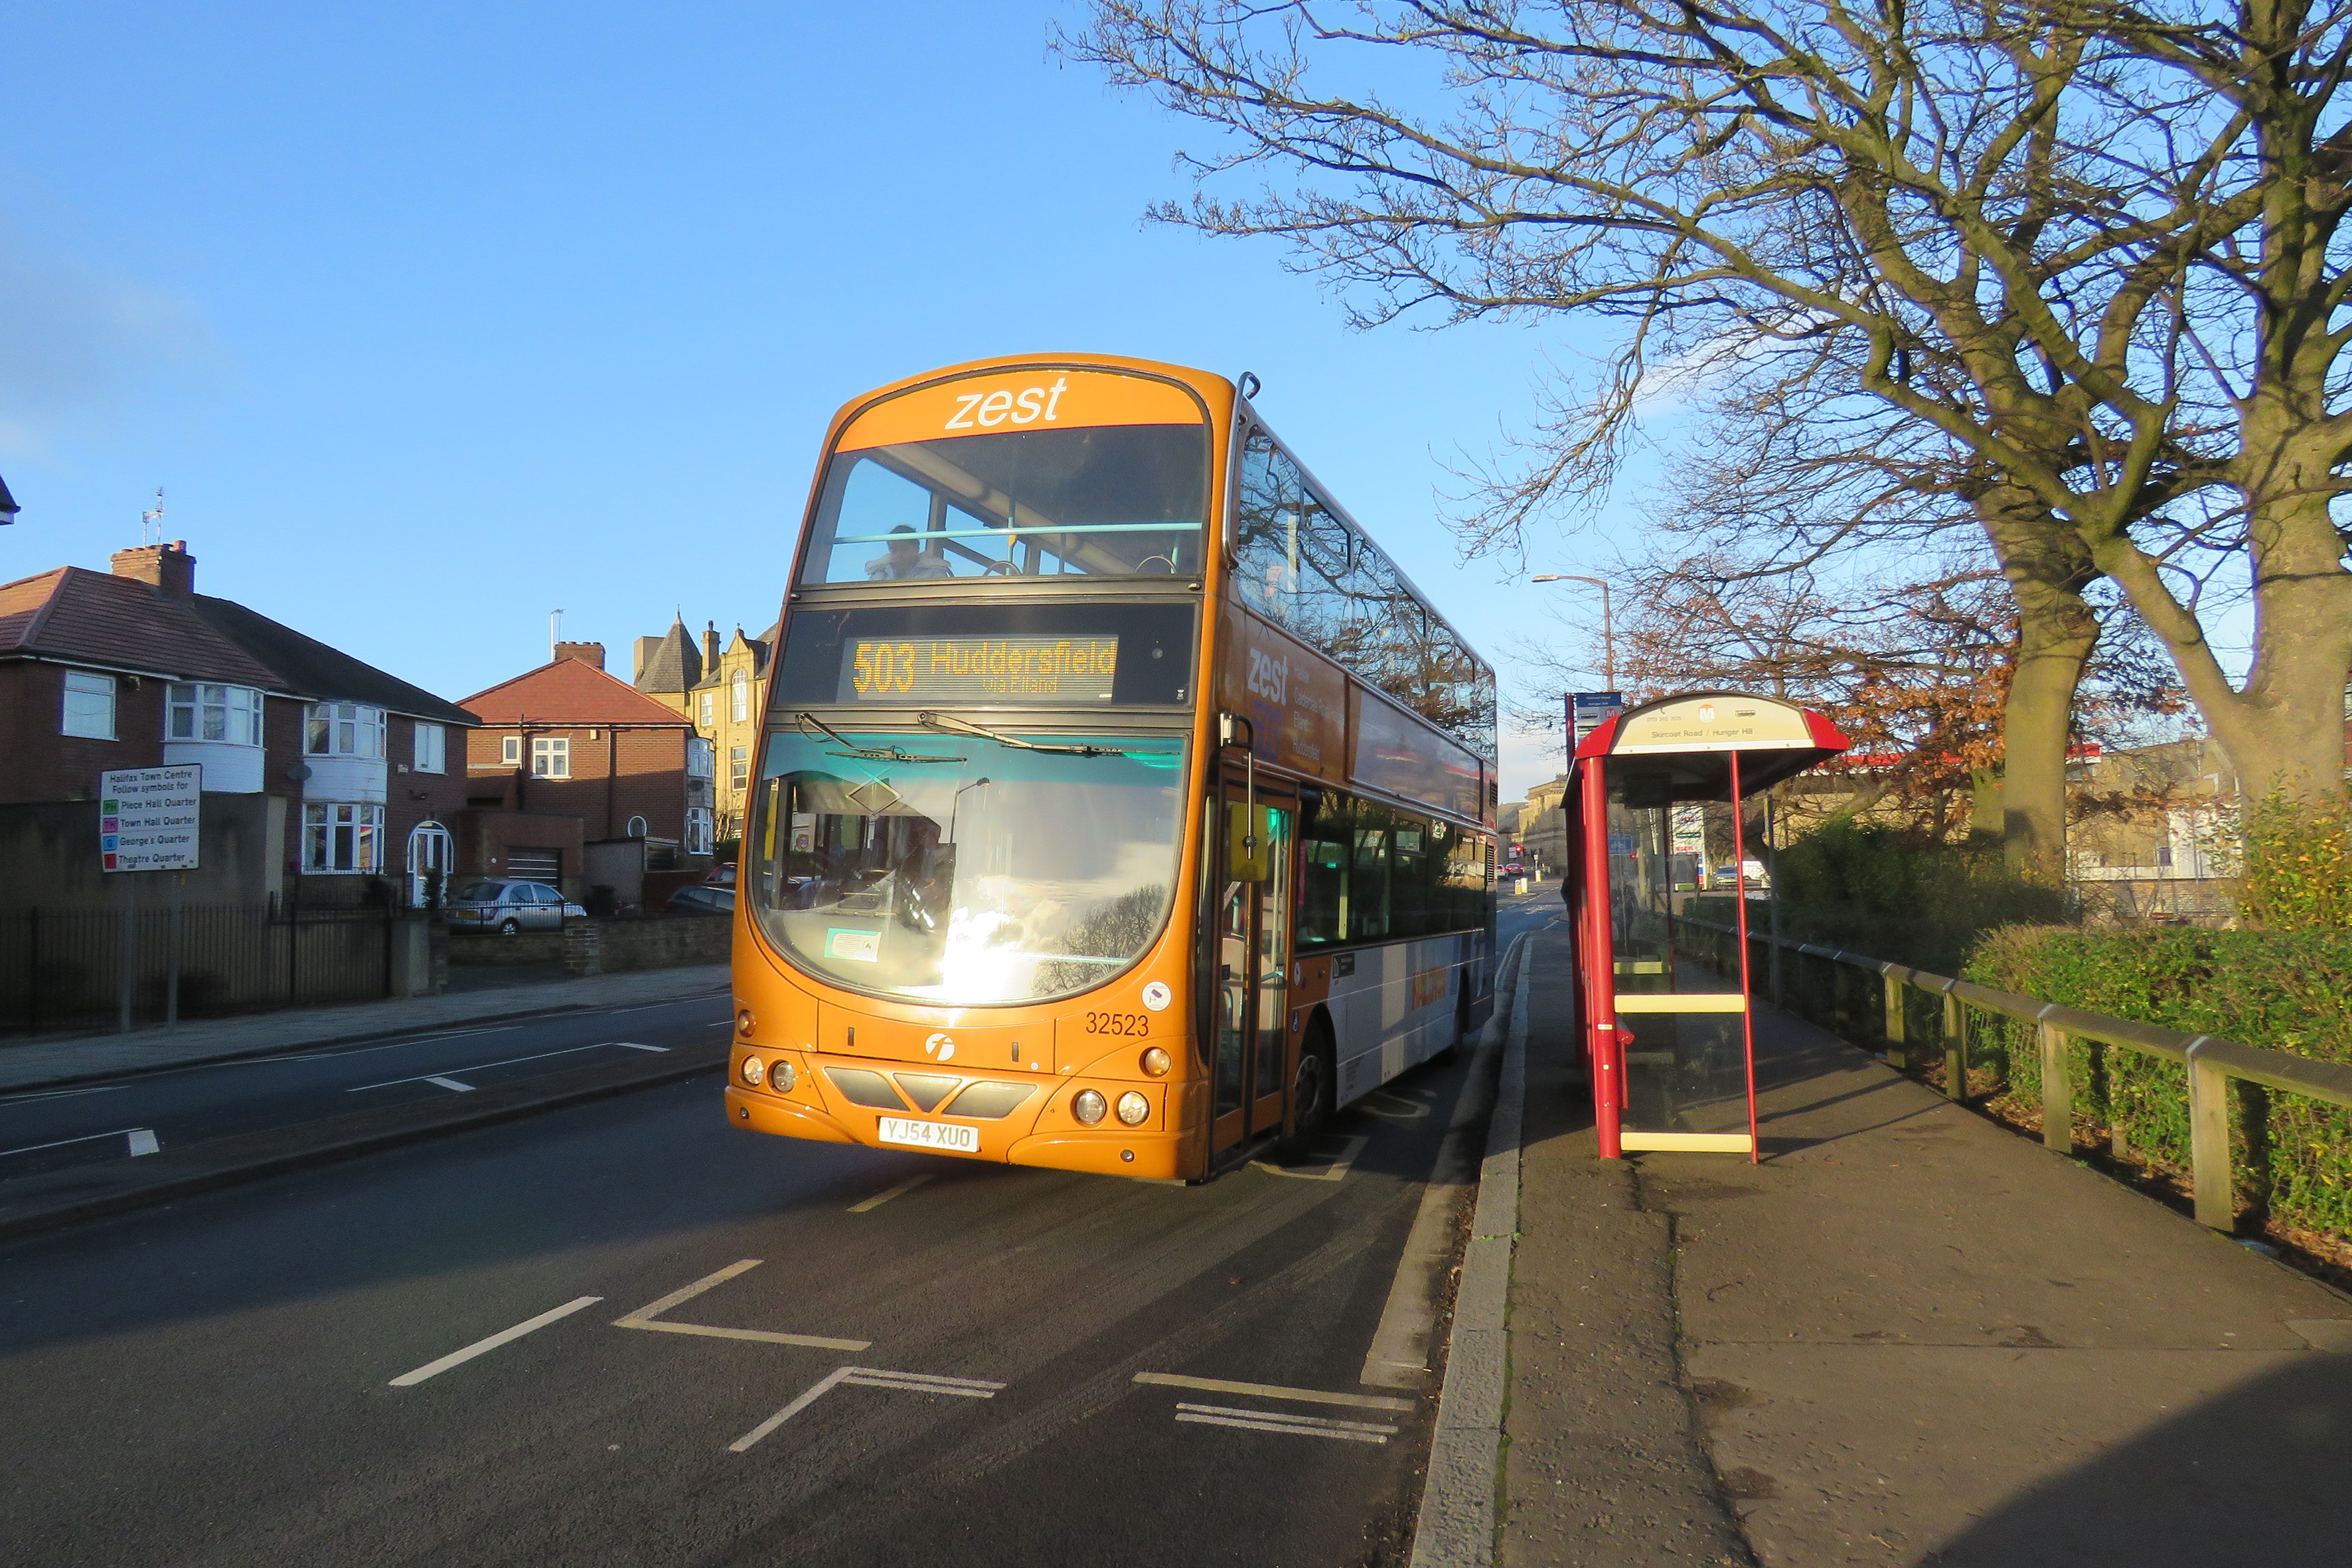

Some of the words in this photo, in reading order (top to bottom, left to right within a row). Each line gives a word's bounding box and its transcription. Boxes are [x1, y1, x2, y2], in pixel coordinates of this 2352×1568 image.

[944, 378, 1067, 430] zest
[853, 643, 915, 693] 503
[931, 641, 1116, 674] Huddersfield
[1247, 648, 1289, 706] zest
[982, 677, 1006, 693] via
[1010, 677, 1058, 693] Elland
[1251, 700, 1283, 761] 503
[110, 774, 137, 783] Halifax
[165, 771, 193, 779] Centre
[113, 785, 138, 794] Follow
[141, 783, 174, 793] symbols
[145, 817, 161, 826] Hall
[163, 817, 196, 825] Quarter
[120, 836, 154, 846] George's
[157, 835, 190, 844] Quarter
[153, 854, 185, 862] Quarter
[1086, 1012, 1148, 1036] 32523
[888, 1120, 931, 1142] YJ54
[937, 1125, 971, 1147] XUO
